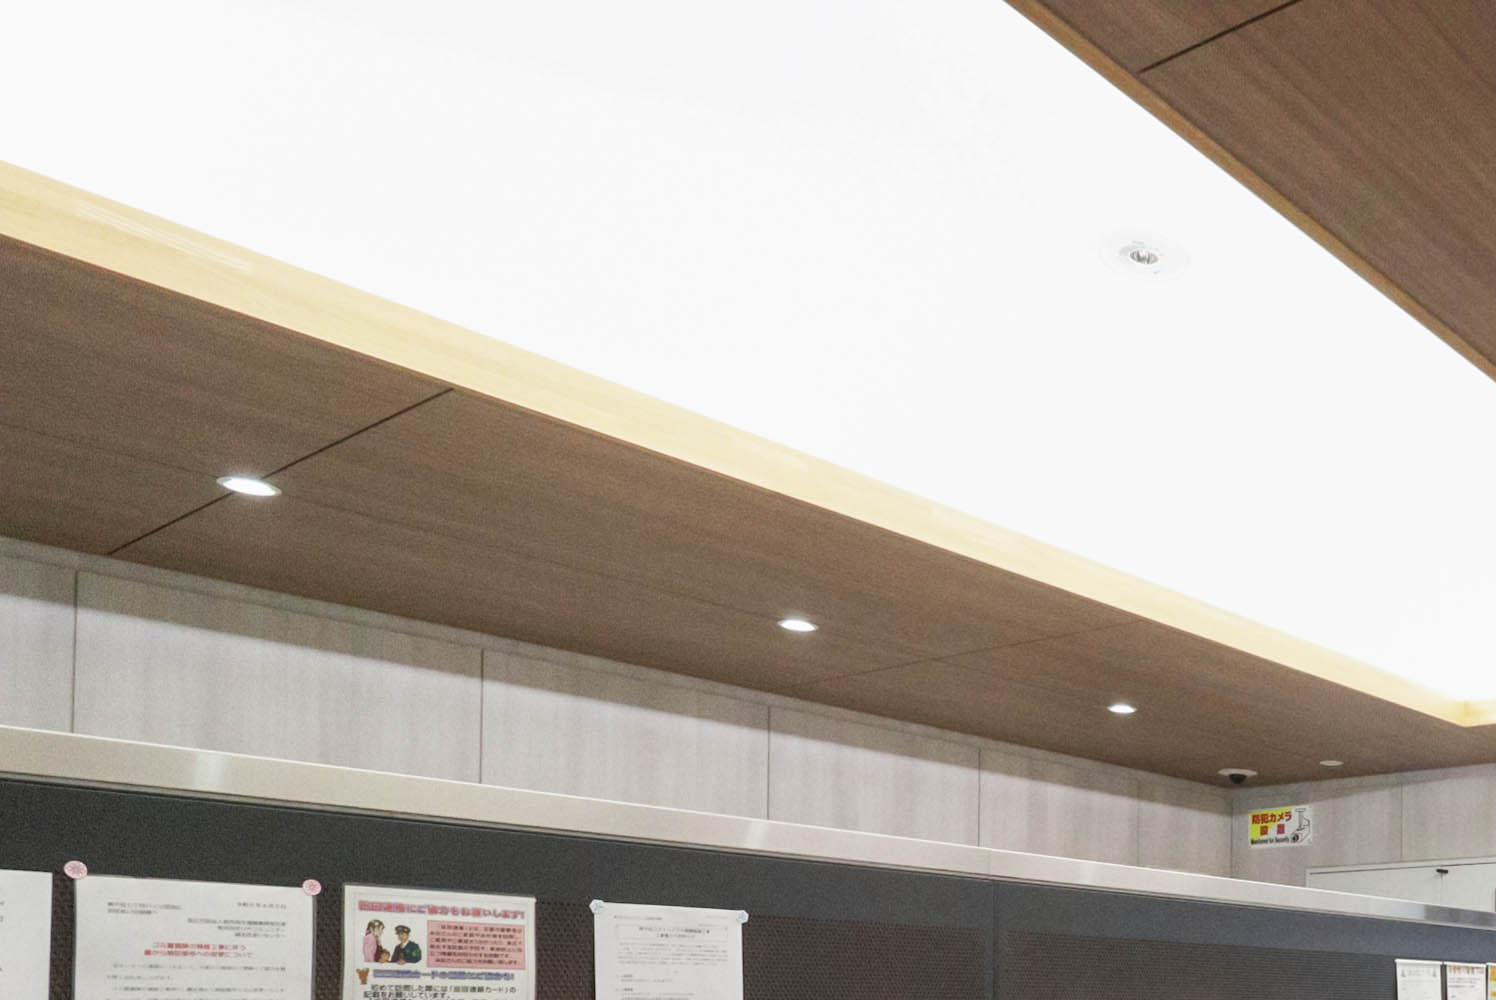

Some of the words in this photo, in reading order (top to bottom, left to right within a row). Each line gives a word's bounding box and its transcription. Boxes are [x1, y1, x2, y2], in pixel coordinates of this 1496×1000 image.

[1252, 810, 1292, 825] 防犯カメラ
